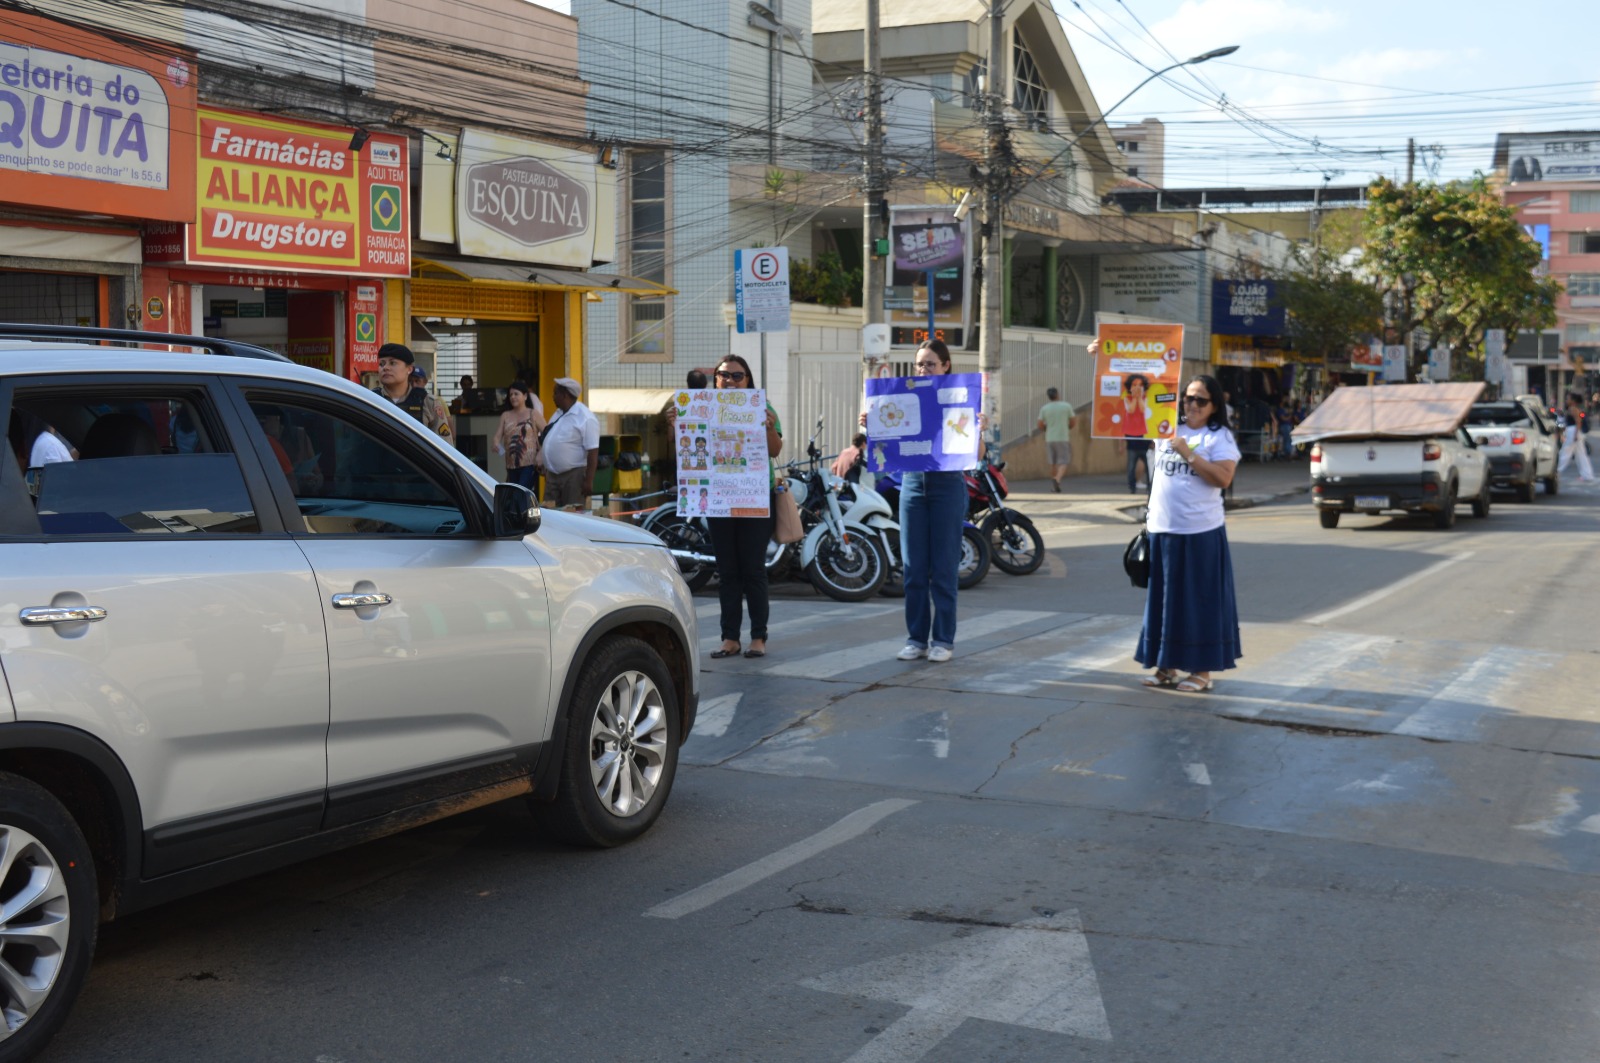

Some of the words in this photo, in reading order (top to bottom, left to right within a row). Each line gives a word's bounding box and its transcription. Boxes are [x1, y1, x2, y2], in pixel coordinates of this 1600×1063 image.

[0, 58, 93, 97] elaria
[104, 74, 140, 106] do
[211, 126, 346, 171] Farmácias
[52, 159, 65, 169] se
[67, 161, 93, 173] pode
[141, 170, 162, 183] 55.6
[367, 166, 386, 180] AQUI
[388, 168, 404, 182] TEM
[502, 168, 546, 186] PASTELARIA
[547, 176, 559, 189] DA
[206, 166, 351, 219] ALIANÇA
[472, 178, 584, 228] ESQUINA
[147, 223, 177, 235] POPULAR
[212, 212, 347, 249] Drugstore
[145, 244, 181, 254] 3332-1856
[367, 234, 406, 250] FARMÁCIA
[368, 250, 406, 265] POPULAR
[760, 258, 770, 274] E
[229, 275, 299, 288] FARMÁCIA
[735, 268, 743, 290] AZUL
[353, 302, 366, 311] AQUI
[367, 303, 378, 312] TEM
[293, 344, 329, 354] Farmácias
[353, 343, 378, 353] FARMÁCIA
[1115, 341, 1166, 353] MAIO
[353, 353, 378, 363] POPULAR
[693, 390, 714, 402] MEU
[717, 391, 747, 406] CORPO
[690, 404, 714, 420] MEU
[713, 479, 739, 488] ABUSO
[741, 477, 758, 487] NÃO
